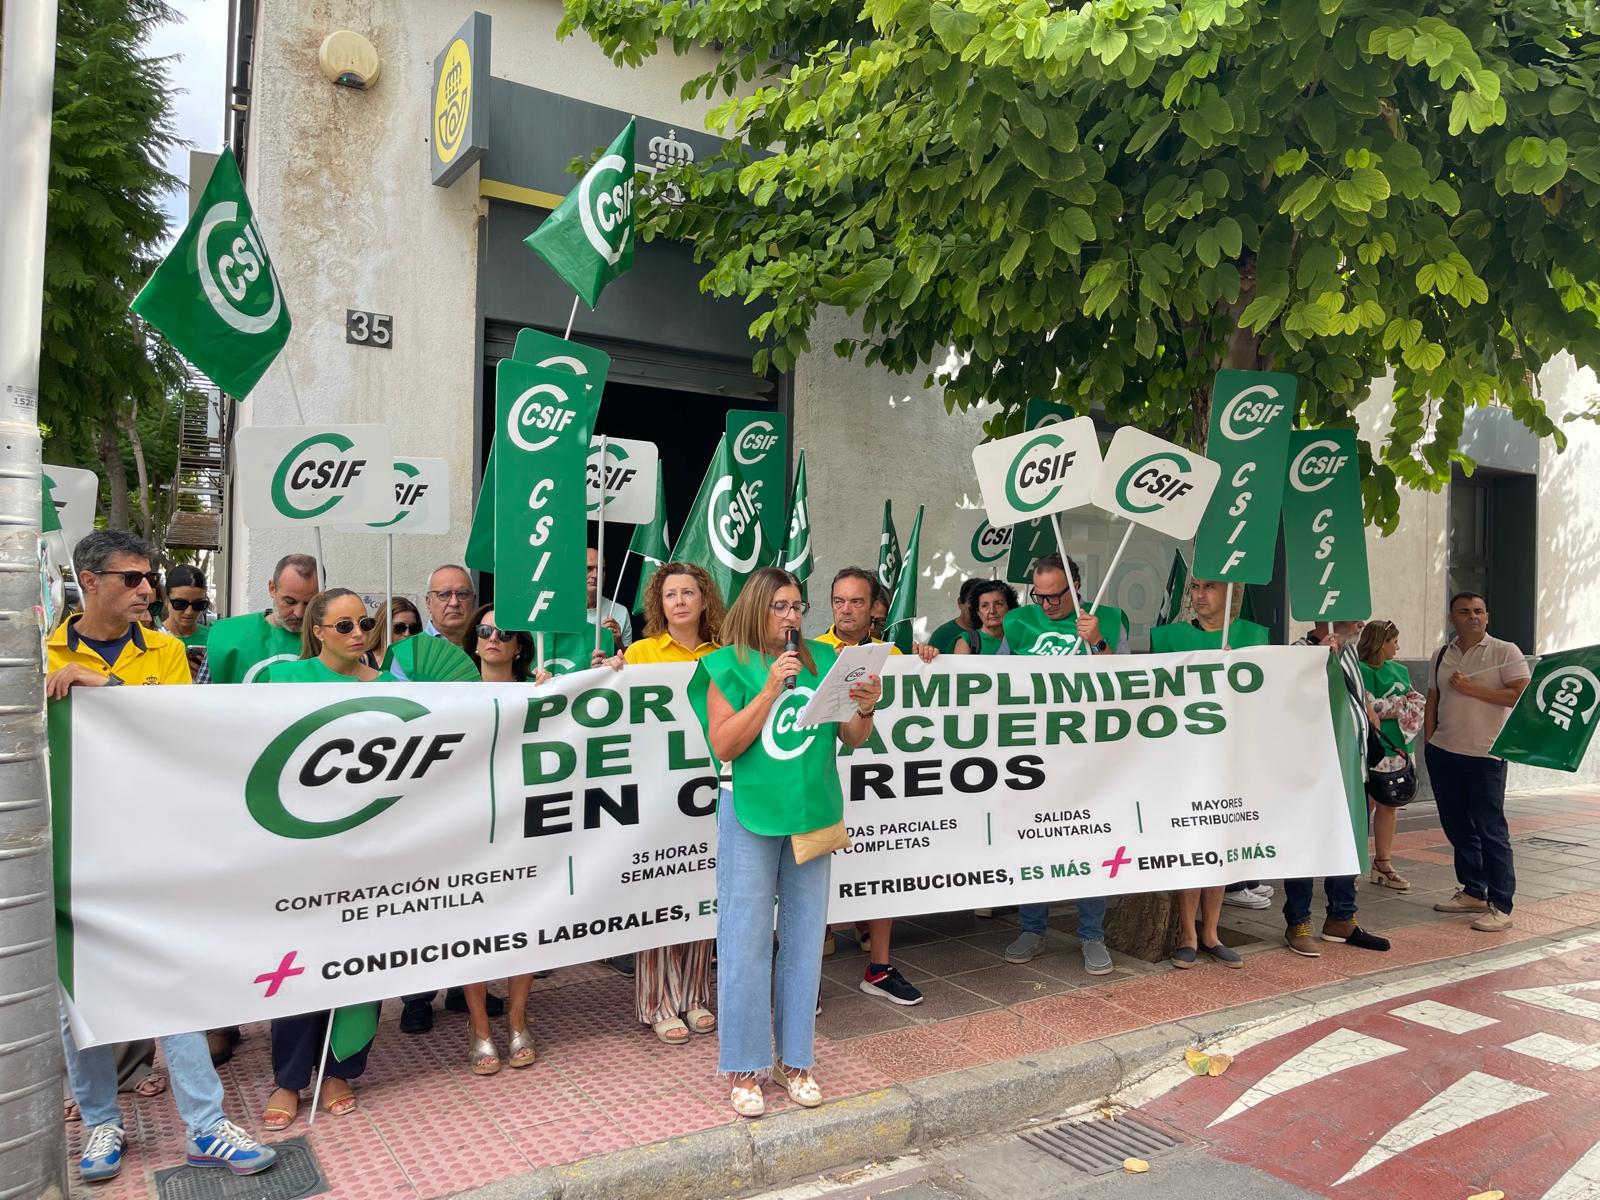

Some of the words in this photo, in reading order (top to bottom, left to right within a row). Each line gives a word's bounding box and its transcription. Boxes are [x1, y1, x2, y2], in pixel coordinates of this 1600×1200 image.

[596, 176, 634, 232] CSIF
[350, 310, 391, 347] 35
[521, 402, 576, 432] CSIF
[1233, 402, 1285, 424] CSIF
[742, 433, 779, 451] CSIF
[291, 459, 367, 490] CSIF
[1019, 450, 1077, 489] CSIF
[1301, 455, 1349, 475] CSIF
[394, 483, 429, 506] SIF
[1133, 468, 1194, 502] CSIF
[981, 527, 1013, 546] CSI
[522, 684, 677, 734] POR
[872, 661, 1265, 711] UMPLIMIENTO
[1549, 676, 1583, 732] CSIF
[298, 732, 466, 788] CSIF
[521, 733, 633, 787] DE
[523, 783, 640, 839] EN
[1034, 809, 1091, 824] SALIDAS
[1171, 810, 1260, 828] RETRIBUCIONES
[1191, 797, 1243, 812] MAYORES
[880, 818, 958, 835] PARCIALES
[1017, 822, 1112, 840] VOLUNTARIAS
[631, 851, 650, 865] 35
[655, 842, 709, 862] HORAS
[620, 857, 717, 884] SEMANALES
[275, 877, 440, 912] CONTRATACIÓN
[447, 865, 538, 889] URGENTE
[321, 931, 528, 980] CONDICIONES
[537, 904, 691, 946] LABORALES,
[838, 868, 1014, 899] RETRIBUCIONES,
[1020, 866, 1044, 881] ES
[1050, 859, 1091, 879] MÁS
[1137, 851, 1223, 871] EMPLEO,
[1226, 848, 1239, 863] ES
[1241, 843, 1277, 860] MÁS
[341, 906, 369, 923] DE
[376, 891, 485, 918] PLANTILLA
